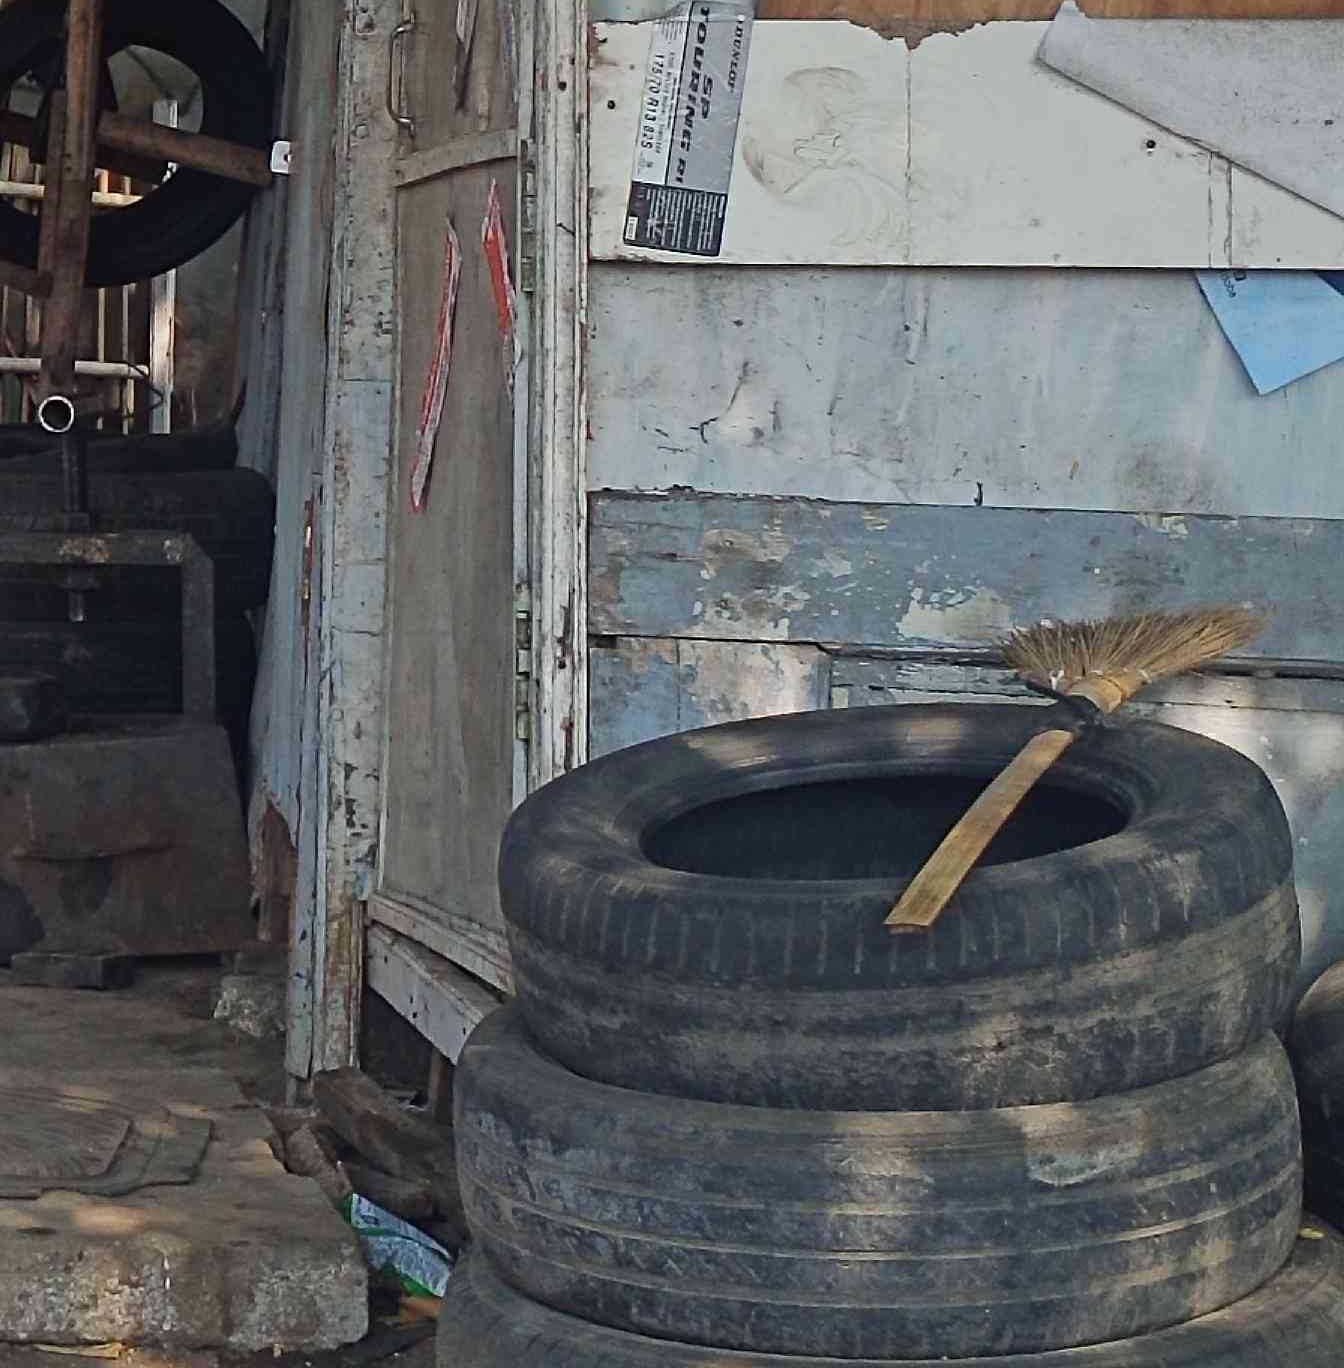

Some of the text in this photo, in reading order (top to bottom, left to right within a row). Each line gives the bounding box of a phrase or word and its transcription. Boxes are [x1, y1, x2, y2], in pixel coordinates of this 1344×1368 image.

[680, 6, 711, 152] TOURING
[701, 73, 714, 119] SP
[644, 95, 660, 122] R13
